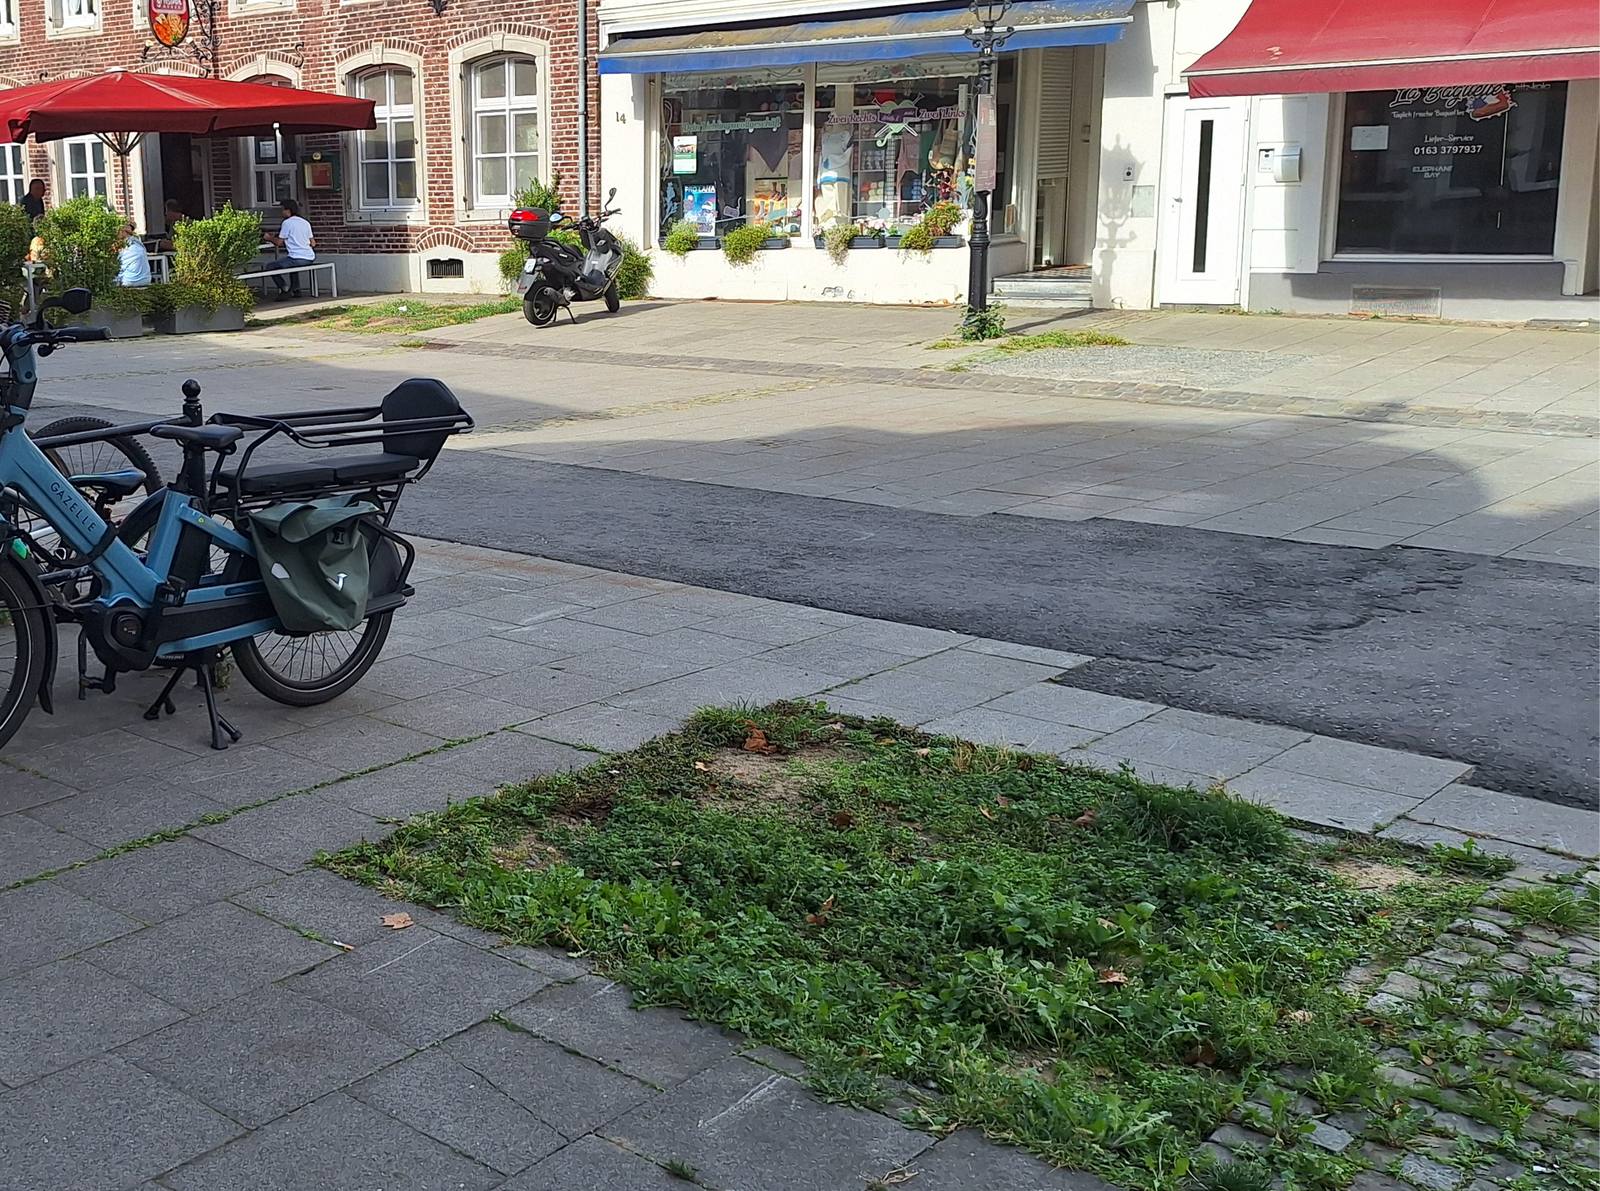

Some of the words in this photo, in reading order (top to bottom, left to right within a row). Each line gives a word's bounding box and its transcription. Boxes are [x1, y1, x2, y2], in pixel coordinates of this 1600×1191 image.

[616, 111, 626, 124] 14
[919, 109, 941, 119] Zwei
[1414, 146, 1438, 155] 0163
[1440, 145, 1483, 155] 3797937
[50, 482, 97, 532] GAZELLE
